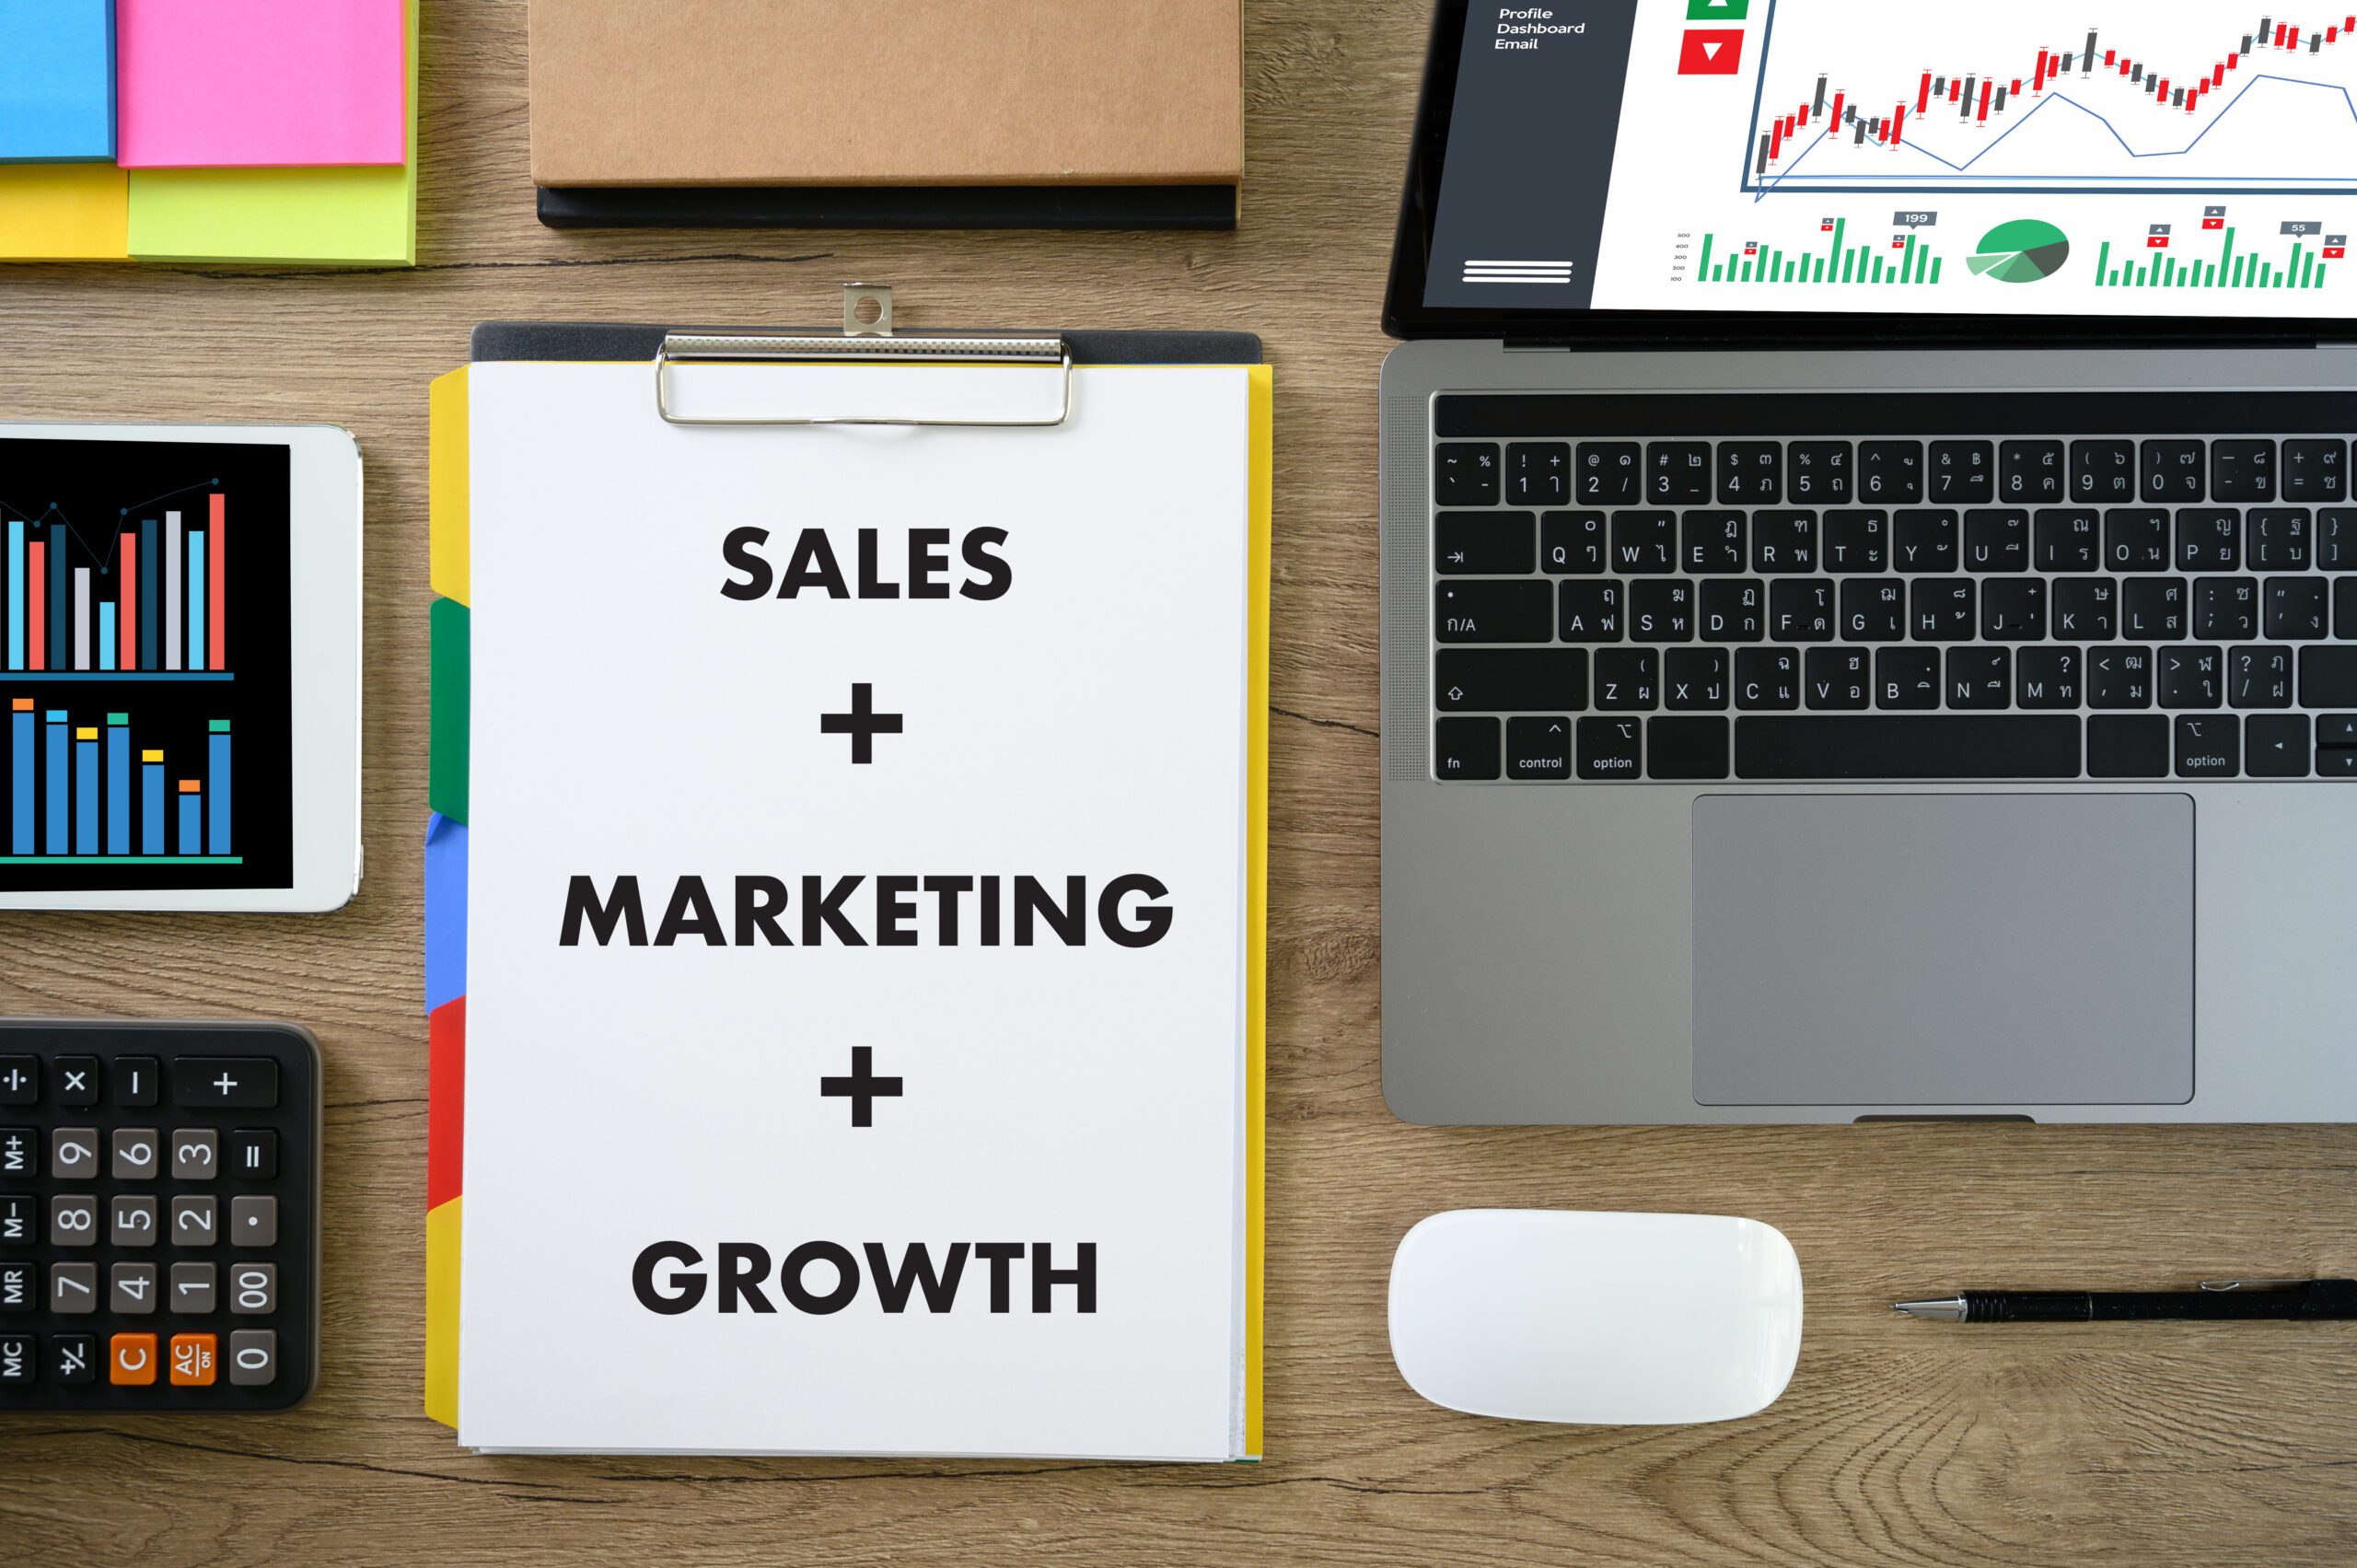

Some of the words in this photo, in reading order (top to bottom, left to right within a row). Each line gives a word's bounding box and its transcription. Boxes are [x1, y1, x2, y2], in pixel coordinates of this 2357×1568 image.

[1499, 7, 1553, 19] Profile
[1497, 22, 1585, 34] Dashboard
[1494, 38, 1538, 50] Email
[1905, 214, 1928, 223] 199
[2291, 224, 2305, 232] 55
[1588, 476, 1599, 493] 2
[1658, 475, 1670, 493] 3
[1728, 475, 1741, 492] 4
[1799, 475, 1811, 492] 5
[1869, 474, 1882, 492] 6
[1941, 474, 1952, 492] 7
[2011, 474, 2023, 492] 8
[2082, 473, 2094, 491] 9
[2152, 473, 2165, 491] 0
[1552, 546, 1566, 564] Q
[1621, 546, 1641, 563] W
[1693, 546, 1704, 563] E
[1763, 545, 1776, 563] R
[1834, 545, 1847, 563] T
[1905, 545, 1918, 562] Y
[1975, 544, 1989, 562] U
[2116, 544, 2130, 561] O
[2187, 544, 2199, 561] P
[720, 526, 1013, 601] SALES
[1571, 614, 1585, 632] A
[1641, 614, 1654, 632] S
[1711, 614, 1724, 631] D
[1781, 614, 1793, 631] F
[1852, 613, 1865, 631] G
[1922, 613, 1935, 631] H
[1992, 613, 2003, 631] J
[2063, 613, 2075, 630] K
[2133, 612, 2144, 630] L
[1606, 683, 1618, 700] Z
[1676, 683, 1689, 700] X
[1746, 682, 1759, 700] C
[1816, 682, 1830, 699] V
[1887, 682, 1899, 700] B
[1956, 681, 1970, 699] N
[2027, 681, 2043, 699] M
[820, 682, 903, 764] +
[1446, 757, 1460, 769] fn
[1518, 756, 1562, 769] control
[1593, 756, 1632, 771] option
[2186, 754, 2225, 769] option
[559, 873, 1174, 948] MARKETING
[820, 1046, 903, 1128] +
[5, 1135, 24, 1169] M+
[59, 1142, 92, 1165] 9
[119, 1143, 152, 1166] 6
[179, 1144, 212, 1166] 3
[57, 1209, 91, 1231] 8
[118, 1210, 151, 1230] 5
[179, 1210, 211, 1230] 2
[4, 1271, 23, 1303] MR
[58, 1276, 90, 1297] 7
[632, 1240, 1097, 1316] GROWTH
[118, 1276, 150, 1300] 4
[178, 1283, 210, 1295] 1
[238, 1272, 268, 1308] 00
[3, 1342, 22, 1376] MC
[119, 1348, 146, 1371] C
[175, 1345, 193, 1376] AC
[202, 1352, 211, 1368] ON
[237, 1348, 269, 1369] 0
